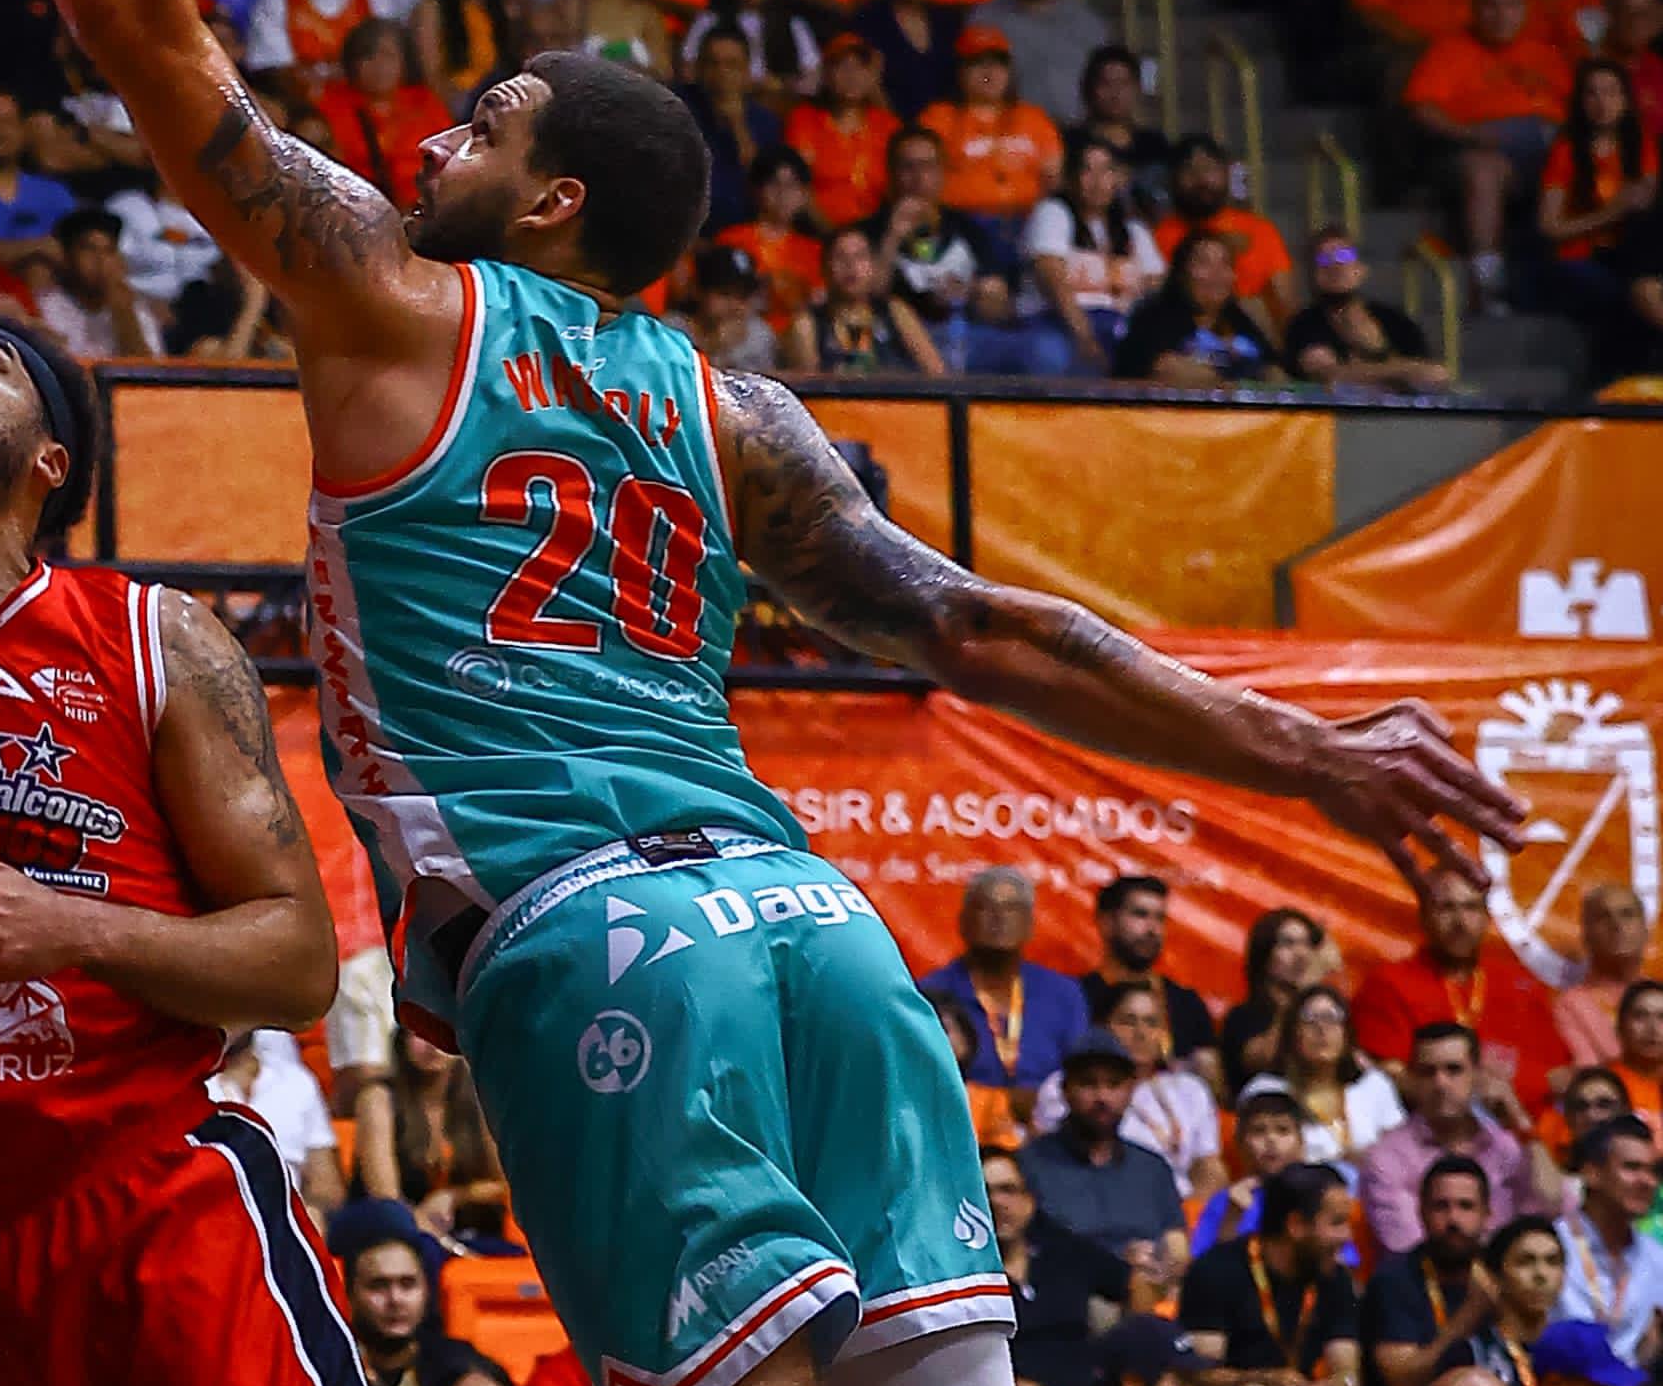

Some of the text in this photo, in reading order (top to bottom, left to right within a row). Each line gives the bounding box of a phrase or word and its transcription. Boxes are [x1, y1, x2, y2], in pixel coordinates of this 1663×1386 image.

[478, 450, 709, 663] 20
[56, 668, 96, 686] LIGA
[880, 790, 913, 835] &
